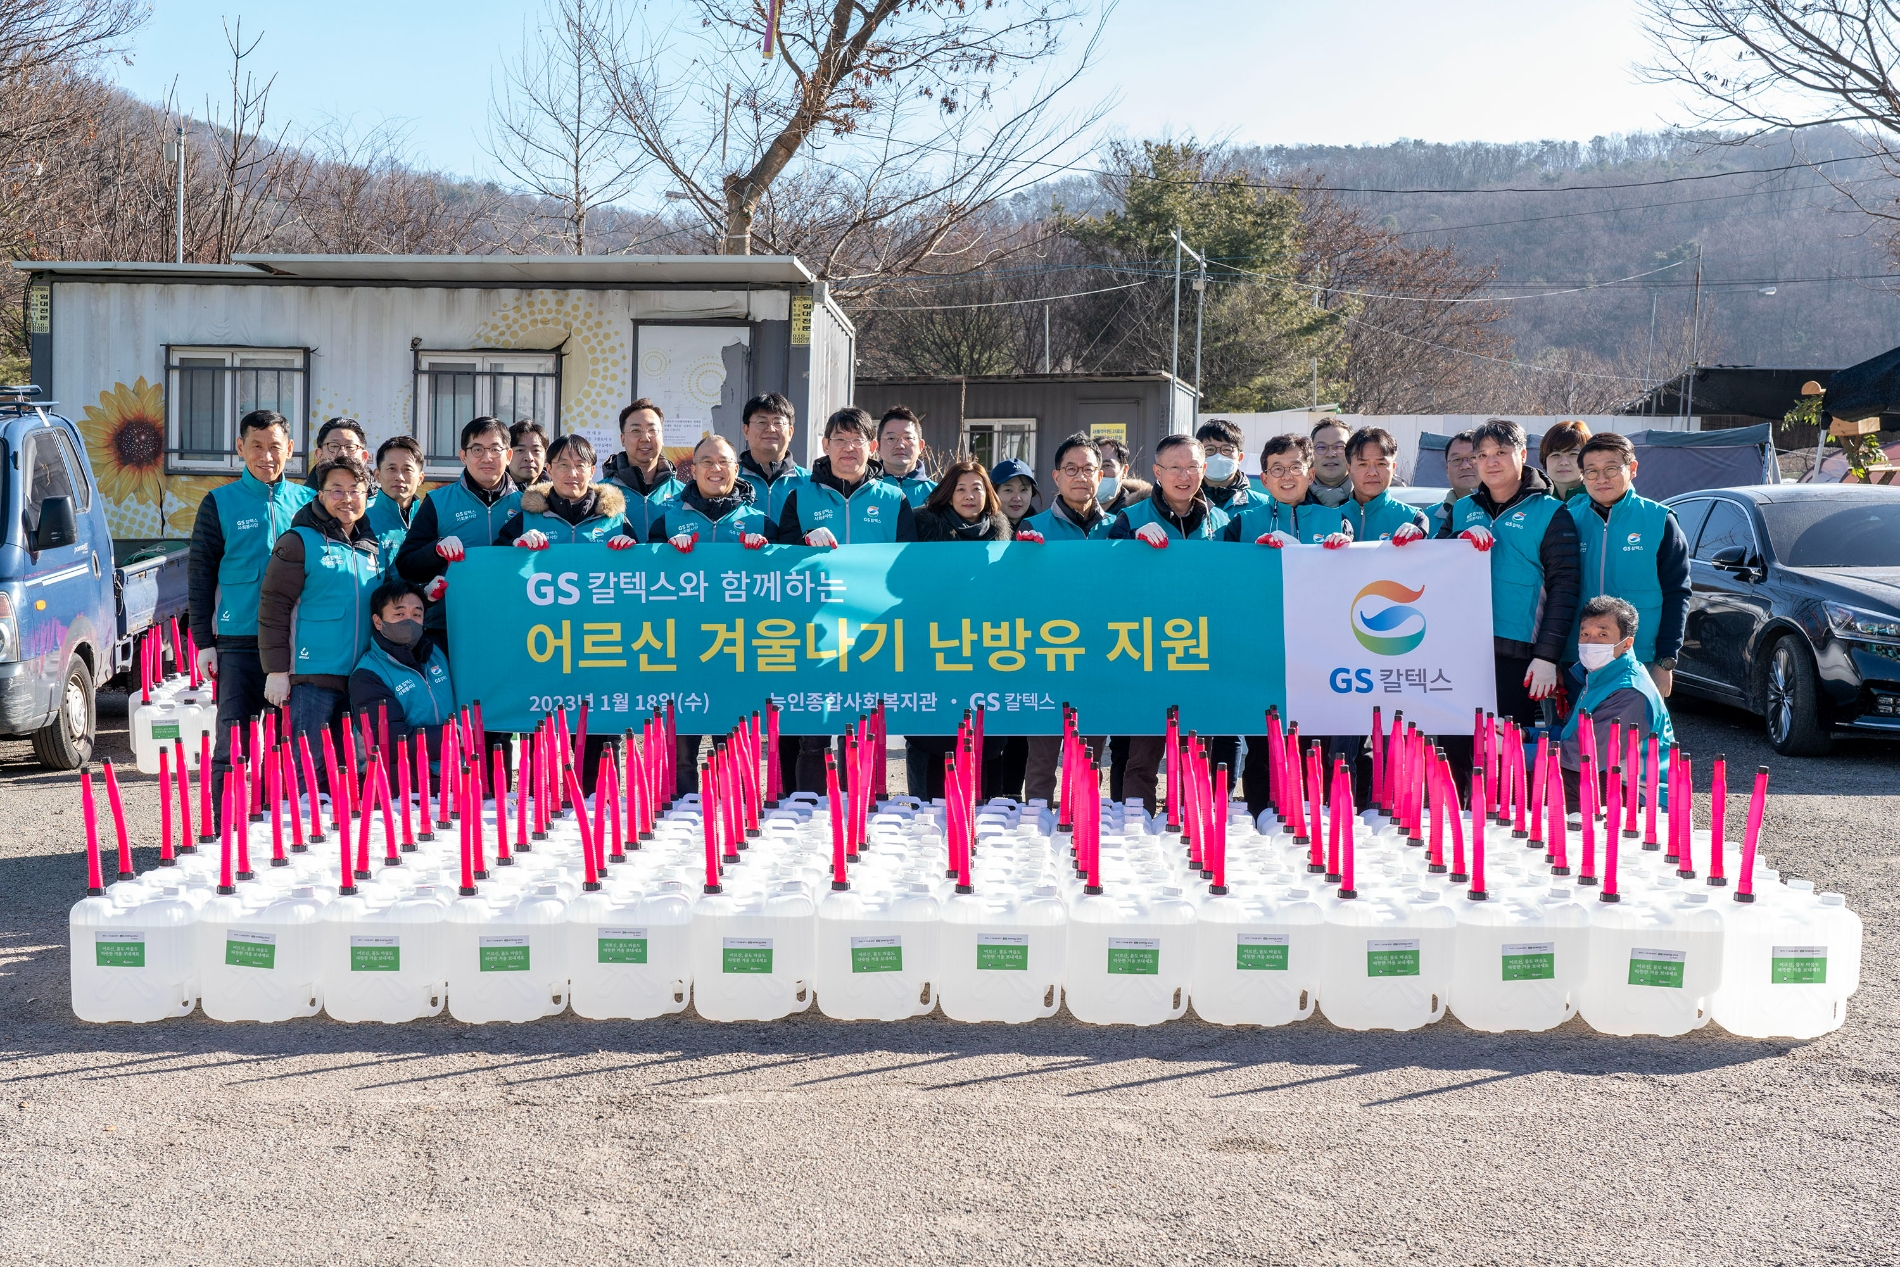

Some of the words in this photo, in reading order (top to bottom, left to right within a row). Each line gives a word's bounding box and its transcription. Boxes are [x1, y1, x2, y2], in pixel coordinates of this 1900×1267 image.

[527, 572, 580, 605] GS
[587, 570, 708, 603] 칼텍스와
[720, 570, 847, 603] 함께하는
[527, 618, 677, 673] 어르신
[699, 617, 904, 673] 겨울나기
[928, 617, 1086, 672] 난방유
[1106, 616, 1210, 671] 지원
[1329, 667, 1374, 694] GS
[1379, 667, 1453, 694] 칼텍스
[600, 692, 629, 712] 1월
[969, 692, 1000, 711] GS
[1004, 691, 1055, 711] 칼텍스
